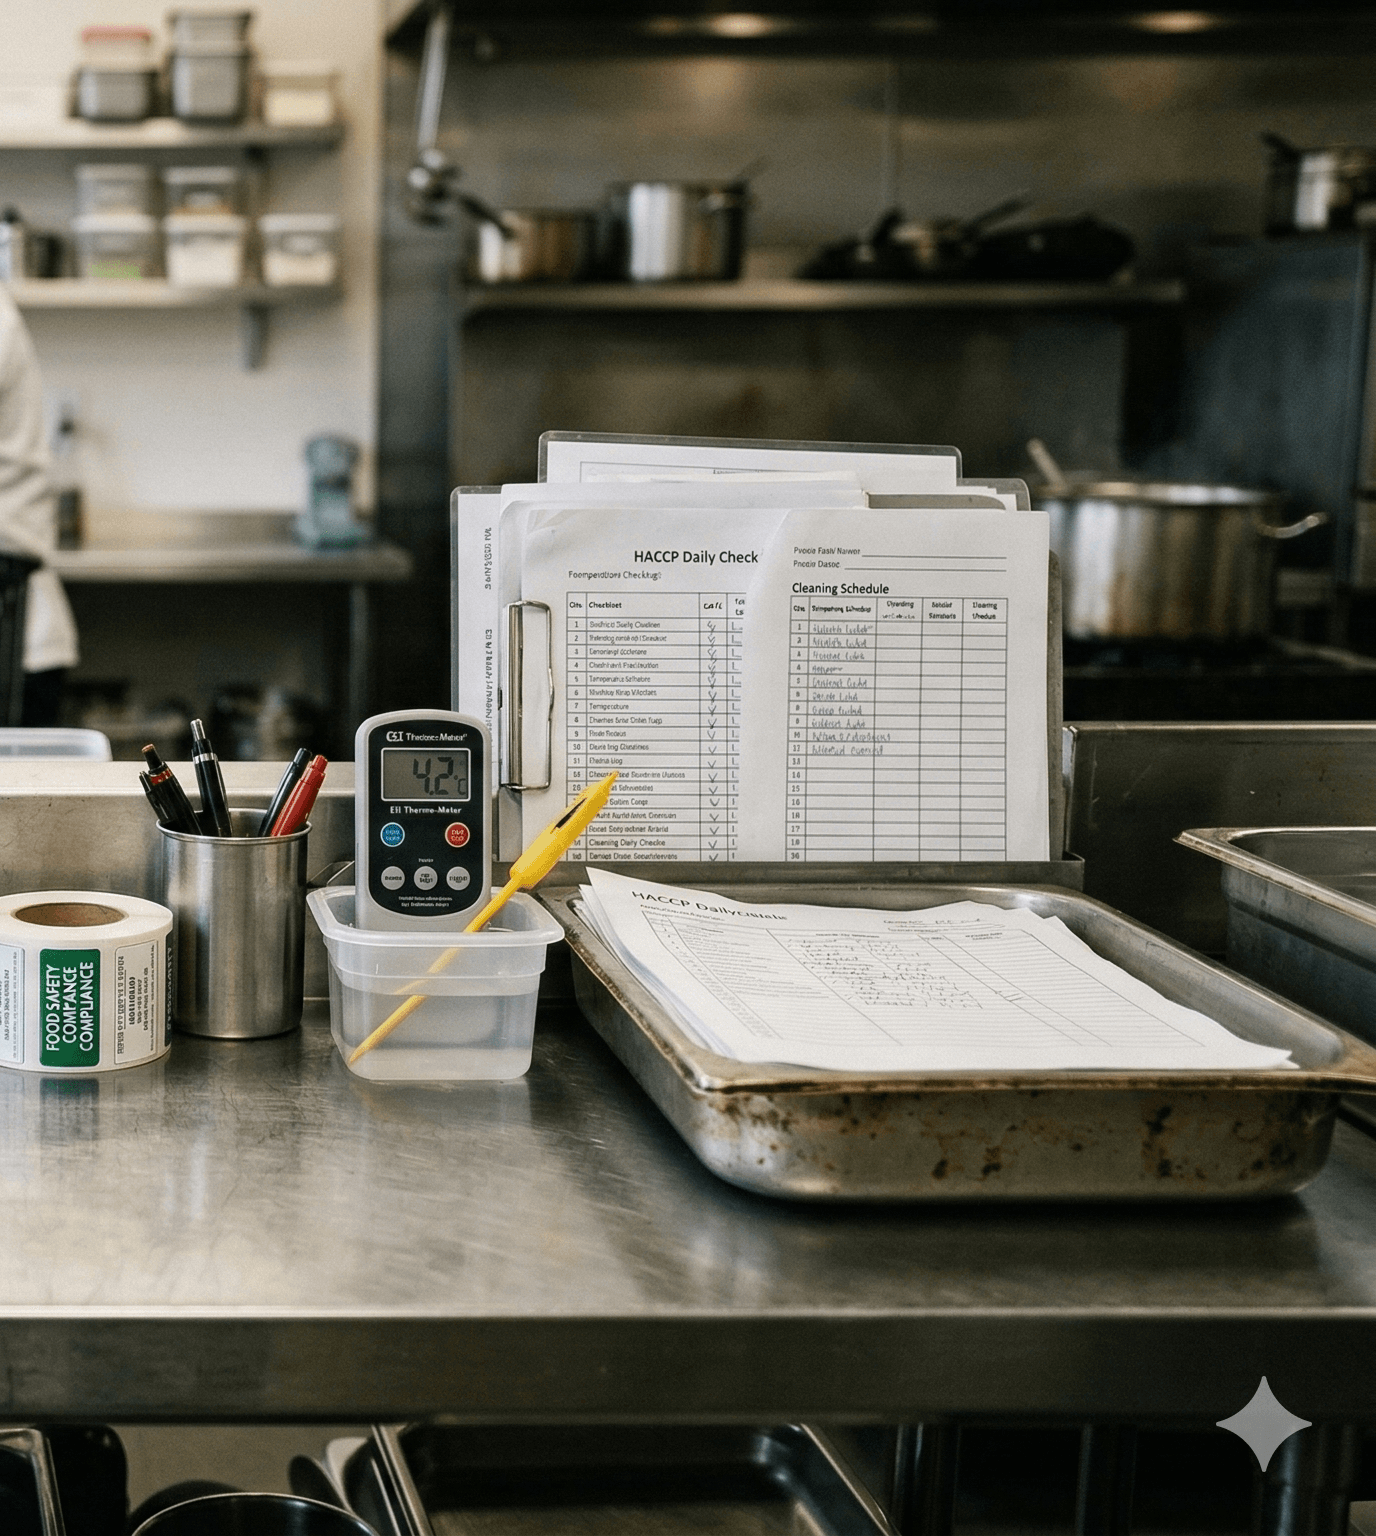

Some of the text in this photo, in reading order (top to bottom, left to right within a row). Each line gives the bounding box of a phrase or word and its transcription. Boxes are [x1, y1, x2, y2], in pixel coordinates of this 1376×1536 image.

[634, 550, 759, 566] HACCP Daily Check
[792, 582, 890, 596] Cleaning Schedule
[631, 890, 691, 908] HACCP
[46, 963, 61, 1052] FOOD SAFETY
